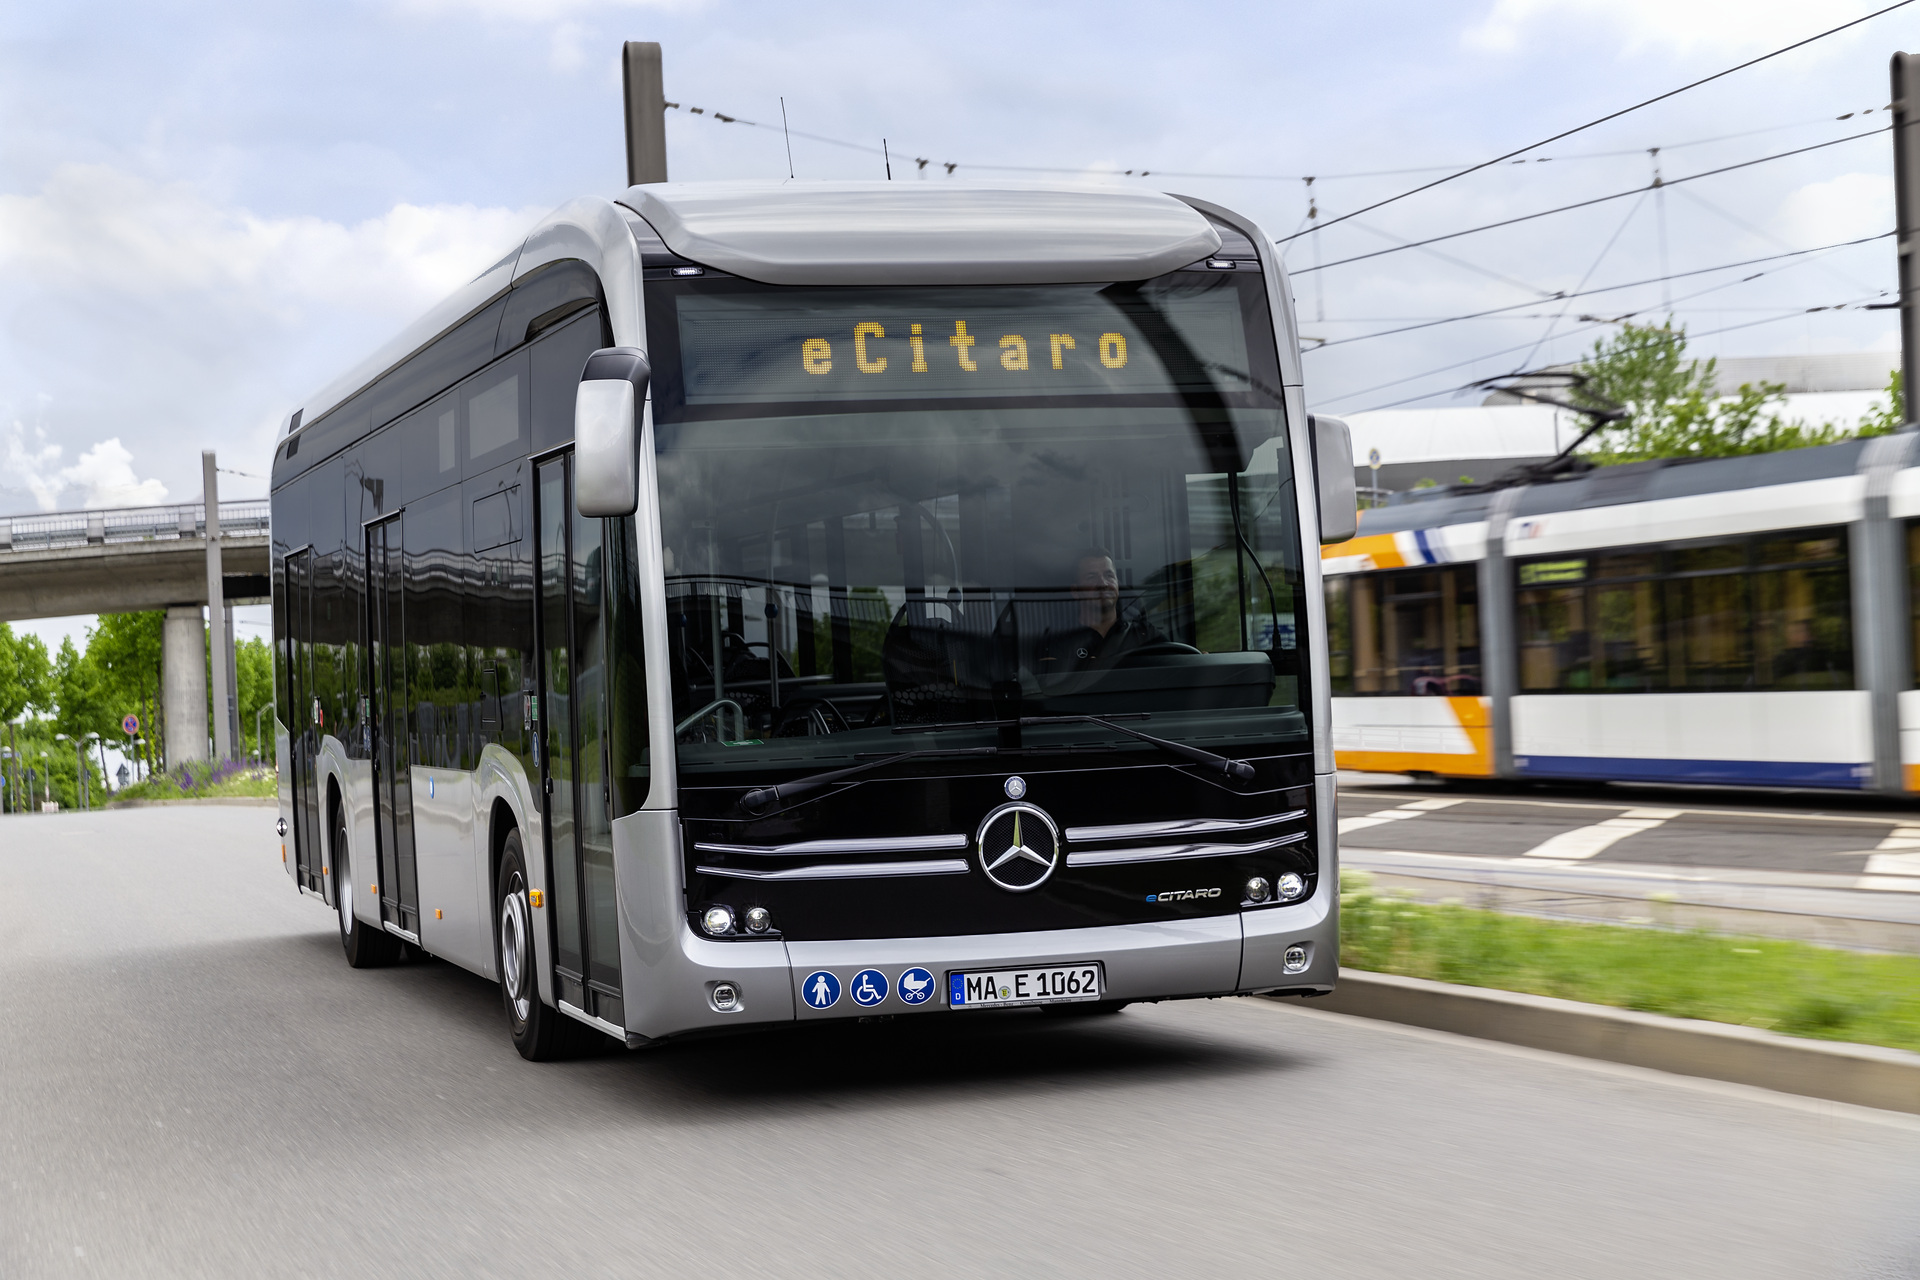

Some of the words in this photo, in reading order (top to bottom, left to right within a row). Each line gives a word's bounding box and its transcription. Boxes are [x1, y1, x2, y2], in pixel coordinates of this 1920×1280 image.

[802, 320, 1127, 375] eCitaro
[1145, 887, 1222, 903] eCITARO
[966, 976, 998, 1001] MA
[1015, 973, 1030, 998] E
[1036, 970, 1096, 996] 1062
